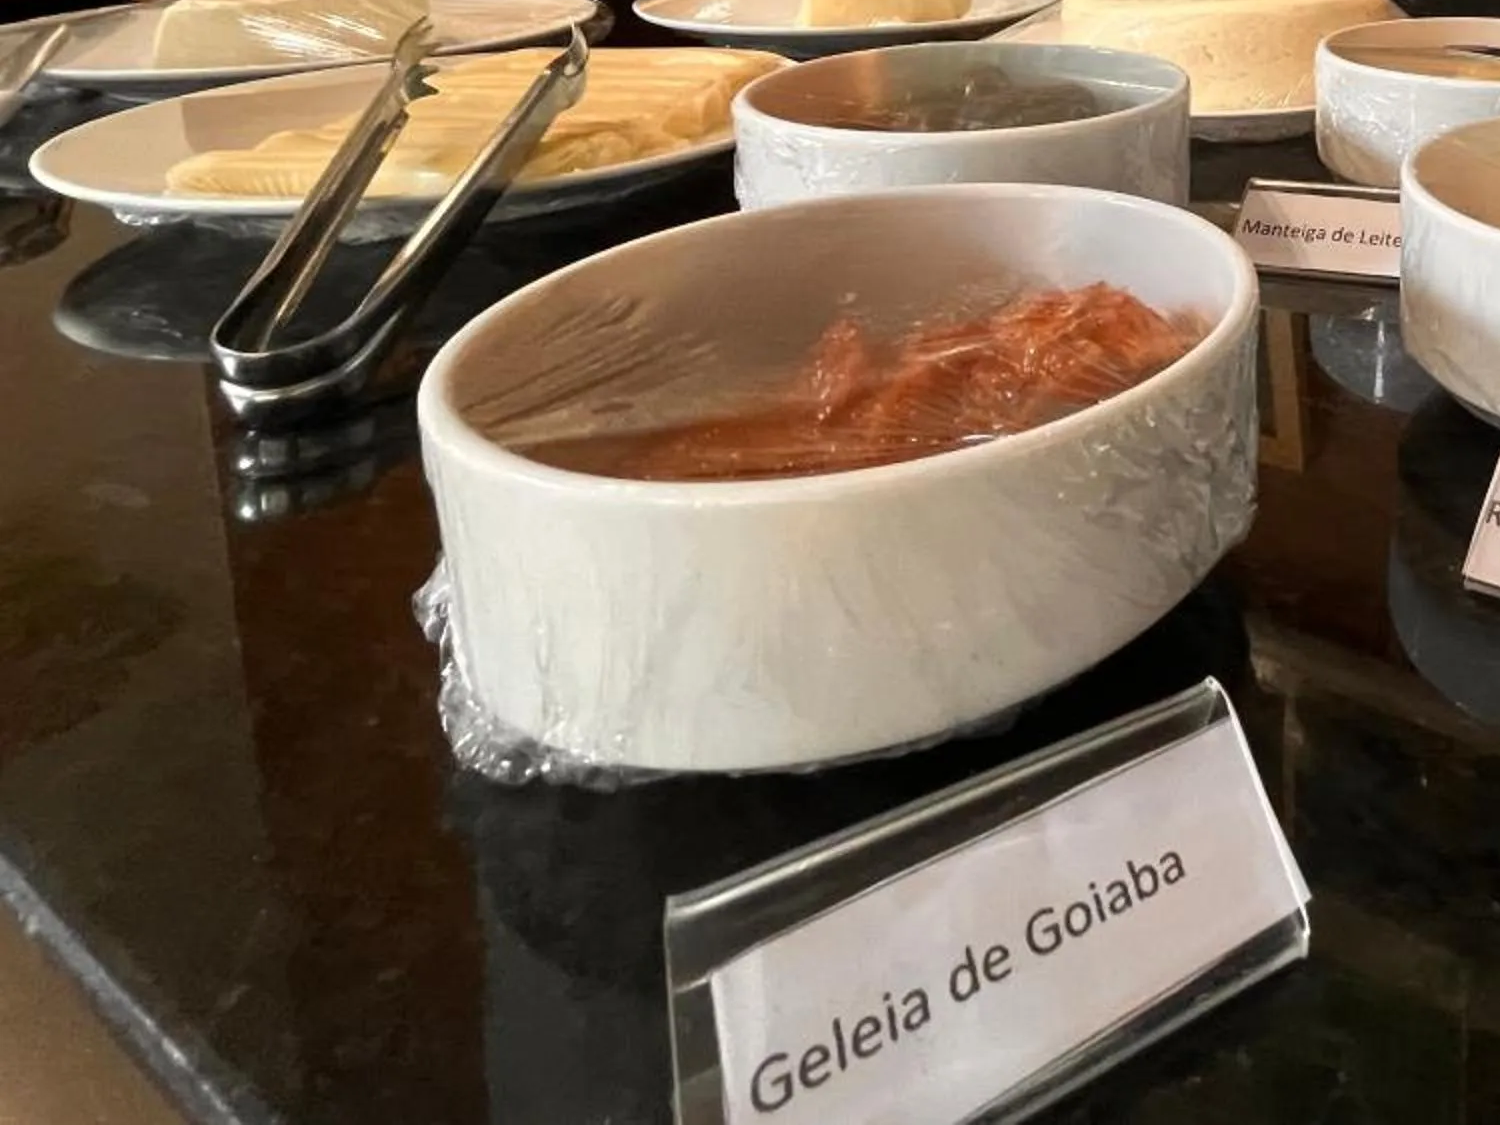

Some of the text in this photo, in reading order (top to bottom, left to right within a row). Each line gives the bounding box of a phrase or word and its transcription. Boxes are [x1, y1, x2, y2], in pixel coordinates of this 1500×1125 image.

[1241, 218, 1402, 248] Manteiga de Leite
[749, 849, 1187, 1115] Geleia de Goiaba
